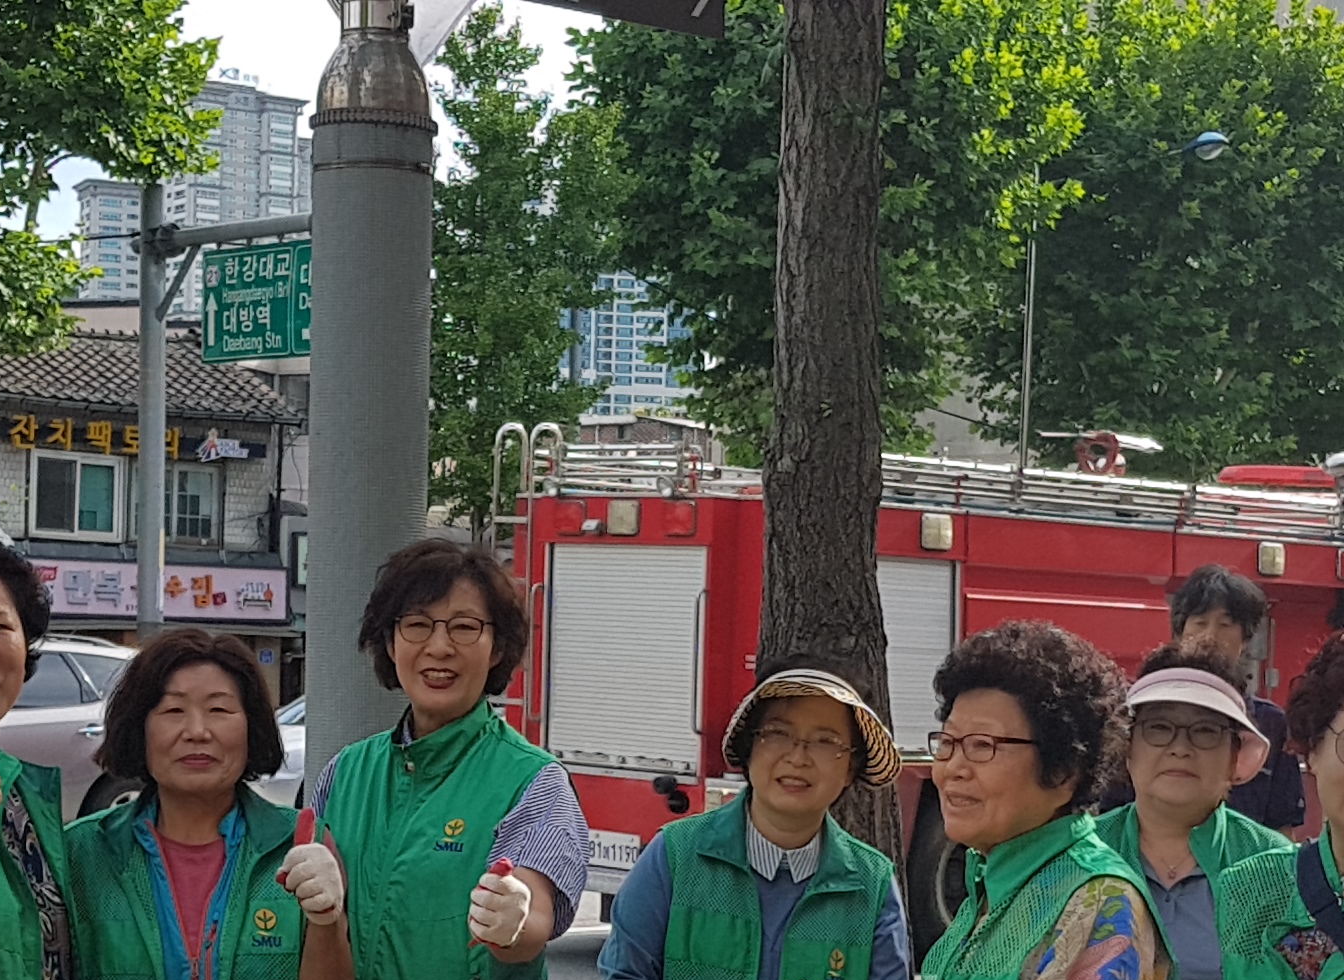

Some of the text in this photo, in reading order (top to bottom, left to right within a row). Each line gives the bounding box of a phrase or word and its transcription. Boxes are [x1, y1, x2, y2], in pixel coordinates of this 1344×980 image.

[224, 252, 290, 284] 한강대교
[223, 303, 270, 333] 대방역
[223, 331, 282, 353] Daebang Stn
[432, 841, 463, 853] SMU
[250, 936, 282, 948] SMU
